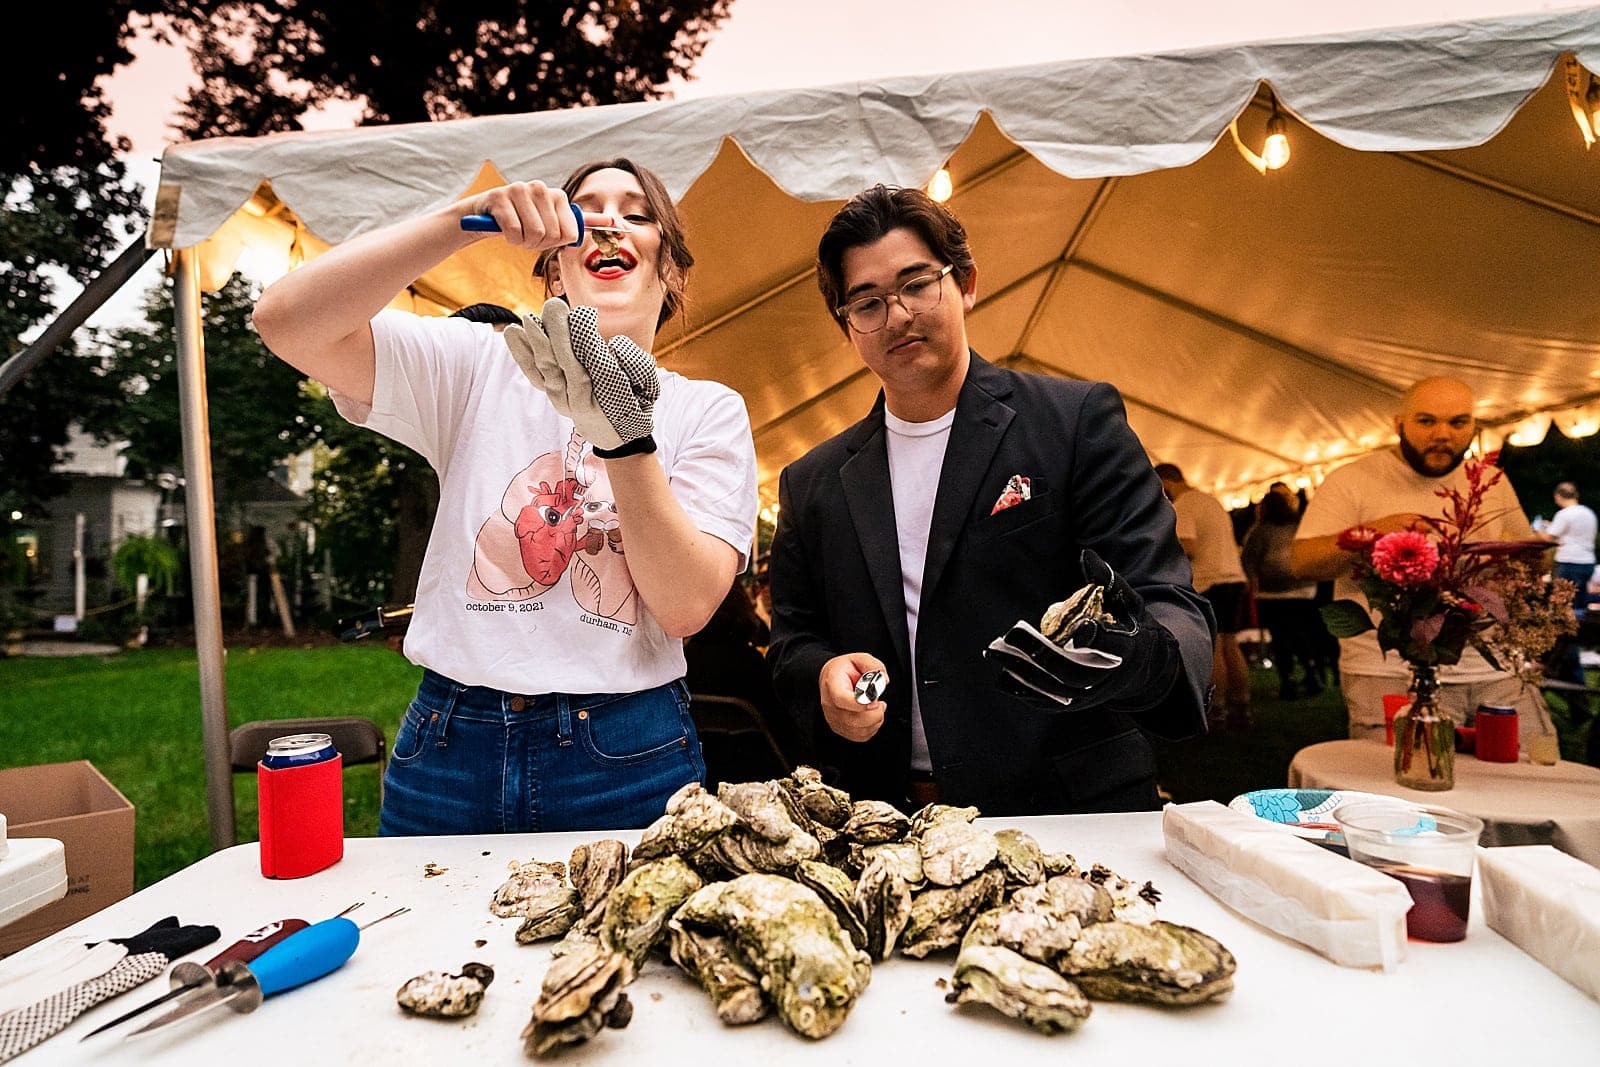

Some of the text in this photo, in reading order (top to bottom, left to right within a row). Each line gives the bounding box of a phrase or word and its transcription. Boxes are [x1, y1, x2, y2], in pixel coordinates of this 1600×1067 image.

[466, 601, 545, 613] october 9, 2021
[580, 613, 620, 633] durham,
